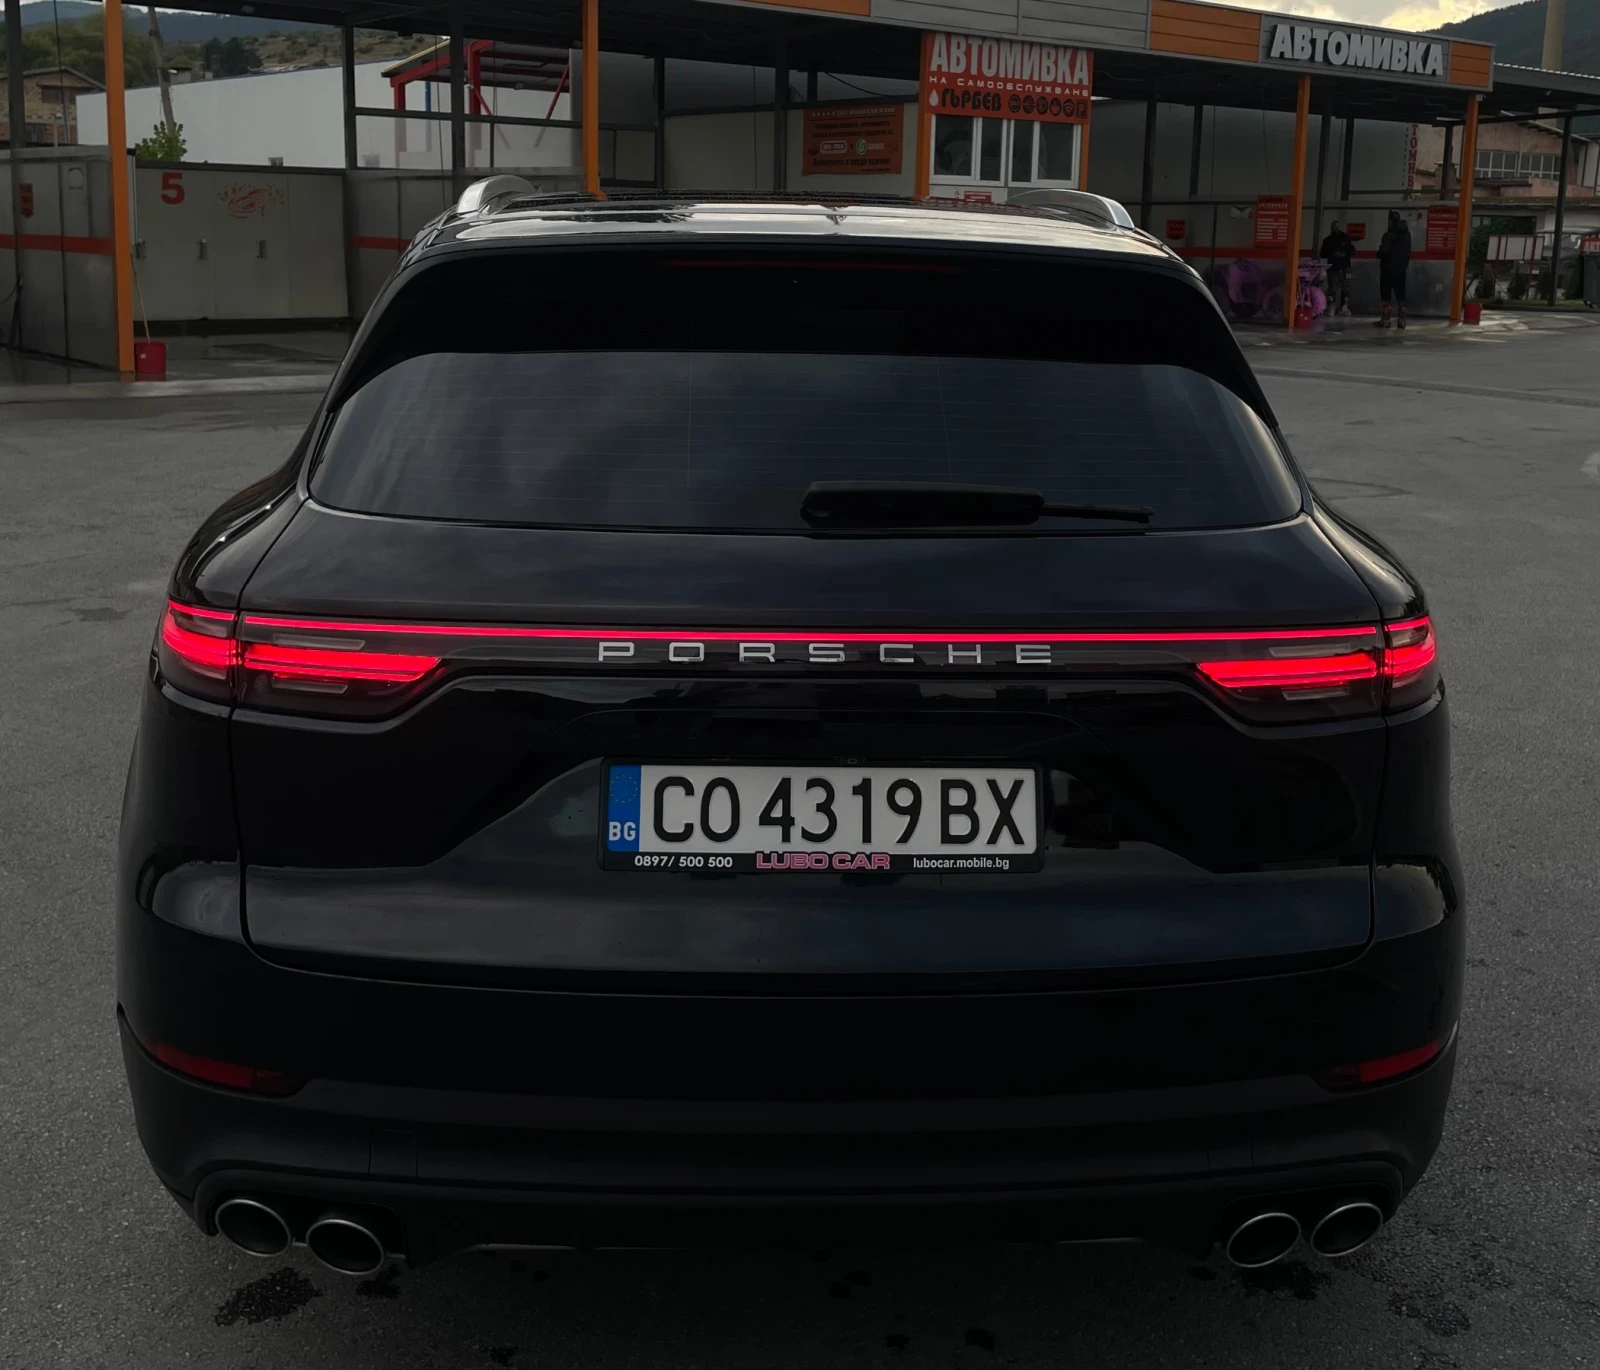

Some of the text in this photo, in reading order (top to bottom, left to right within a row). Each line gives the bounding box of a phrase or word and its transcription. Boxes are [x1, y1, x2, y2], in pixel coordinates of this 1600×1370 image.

[930, 33, 1090, 85] АВТОМИВКА
[1270, 24, 1444, 76] АВТОМИВКА
[929, 76, 947, 84] НА
[161, 172, 185, 205] 5
[598, 642, 1052, 663] PORSCHE
[654, 777, 1025, 845] CO 4319 BX
[608, 821, 637, 841] BG
[634, 855, 733, 868] 0897/ 500 500
[756, 852, 891, 870] LUBO CAR
[913, 856, 1010, 871] lubocar.mobile.bg
